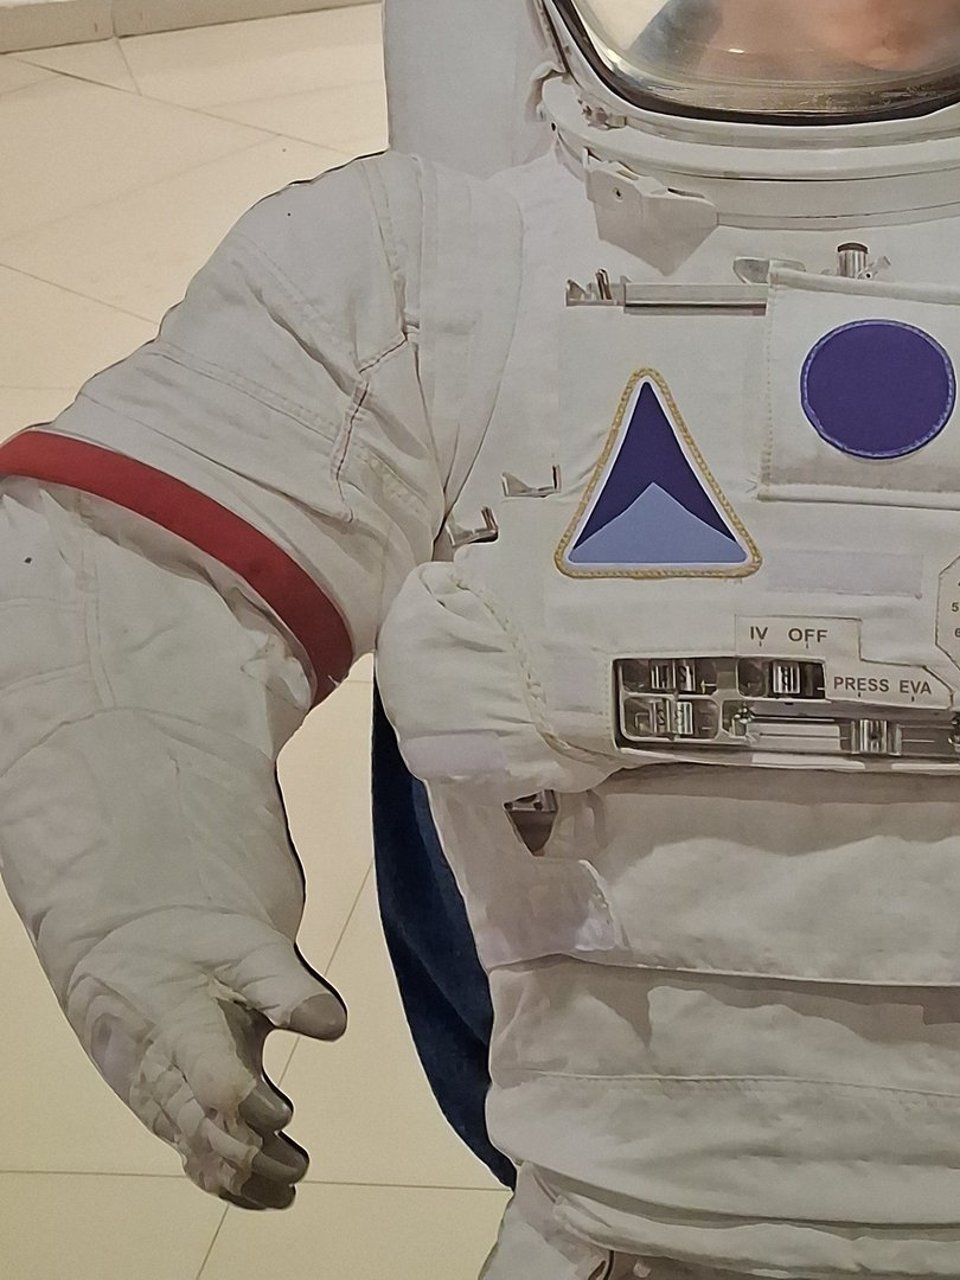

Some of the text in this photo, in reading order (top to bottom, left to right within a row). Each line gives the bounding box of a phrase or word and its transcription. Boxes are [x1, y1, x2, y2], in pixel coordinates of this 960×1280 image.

[952, 603, 959, 612] 5
[749, 625, 829, 643] IV OFF
[955, 628, 960, 637] 6
[832, 676, 933, 695] PRESS EVA
